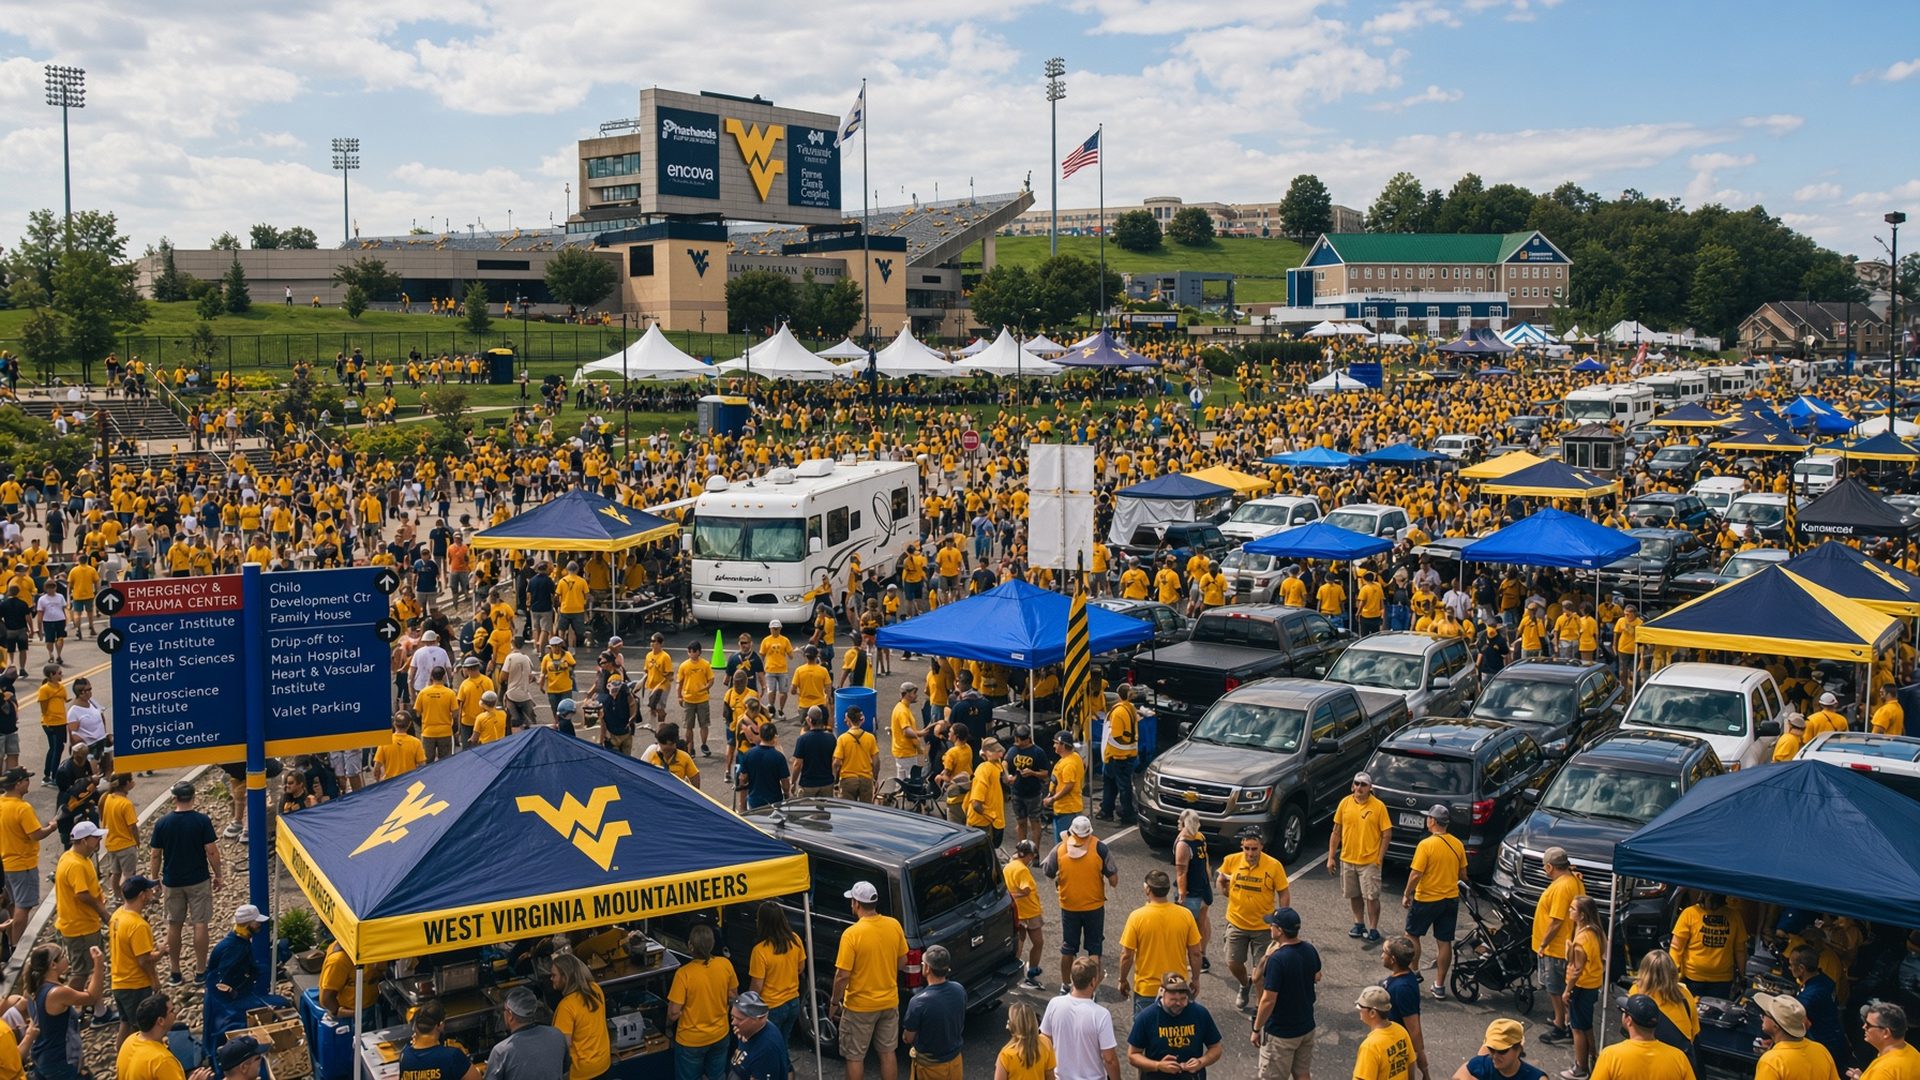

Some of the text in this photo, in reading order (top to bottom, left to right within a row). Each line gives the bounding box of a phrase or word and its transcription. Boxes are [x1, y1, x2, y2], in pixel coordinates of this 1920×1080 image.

[667, 164, 714, 181] encova
[128, 582, 221, 598] EMERGENCY &
[128, 595, 238, 611] TRAUMA CENTER
[270, 592, 371, 608] Development Ctr
[128, 617, 235, 633] Cancer Institute
[270, 610, 352, 624] Family House
[129, 637, 215, 654] Eye Institute
[328, 634, 344, 644] to:
[130, 653, 235, 670] Health Sciences
[272, 647, 360, 665] Main Hospital
[130, 671, 175, 683] Center
[272, 663, 376, 680] Heart & Vascular
[130, 687, 219, 703] Neuroscience
[272, 682, 325, 695] Institute
[130, 703, 188, 716] Institute
[272, 702, 361, 718] Valet Parking
[131, 720, 194, 735] Physician
[131, 732, 220, 749] Office Center
[423, 873, 748, 945] WEST VIRGINIA MOUNTAINEERS
